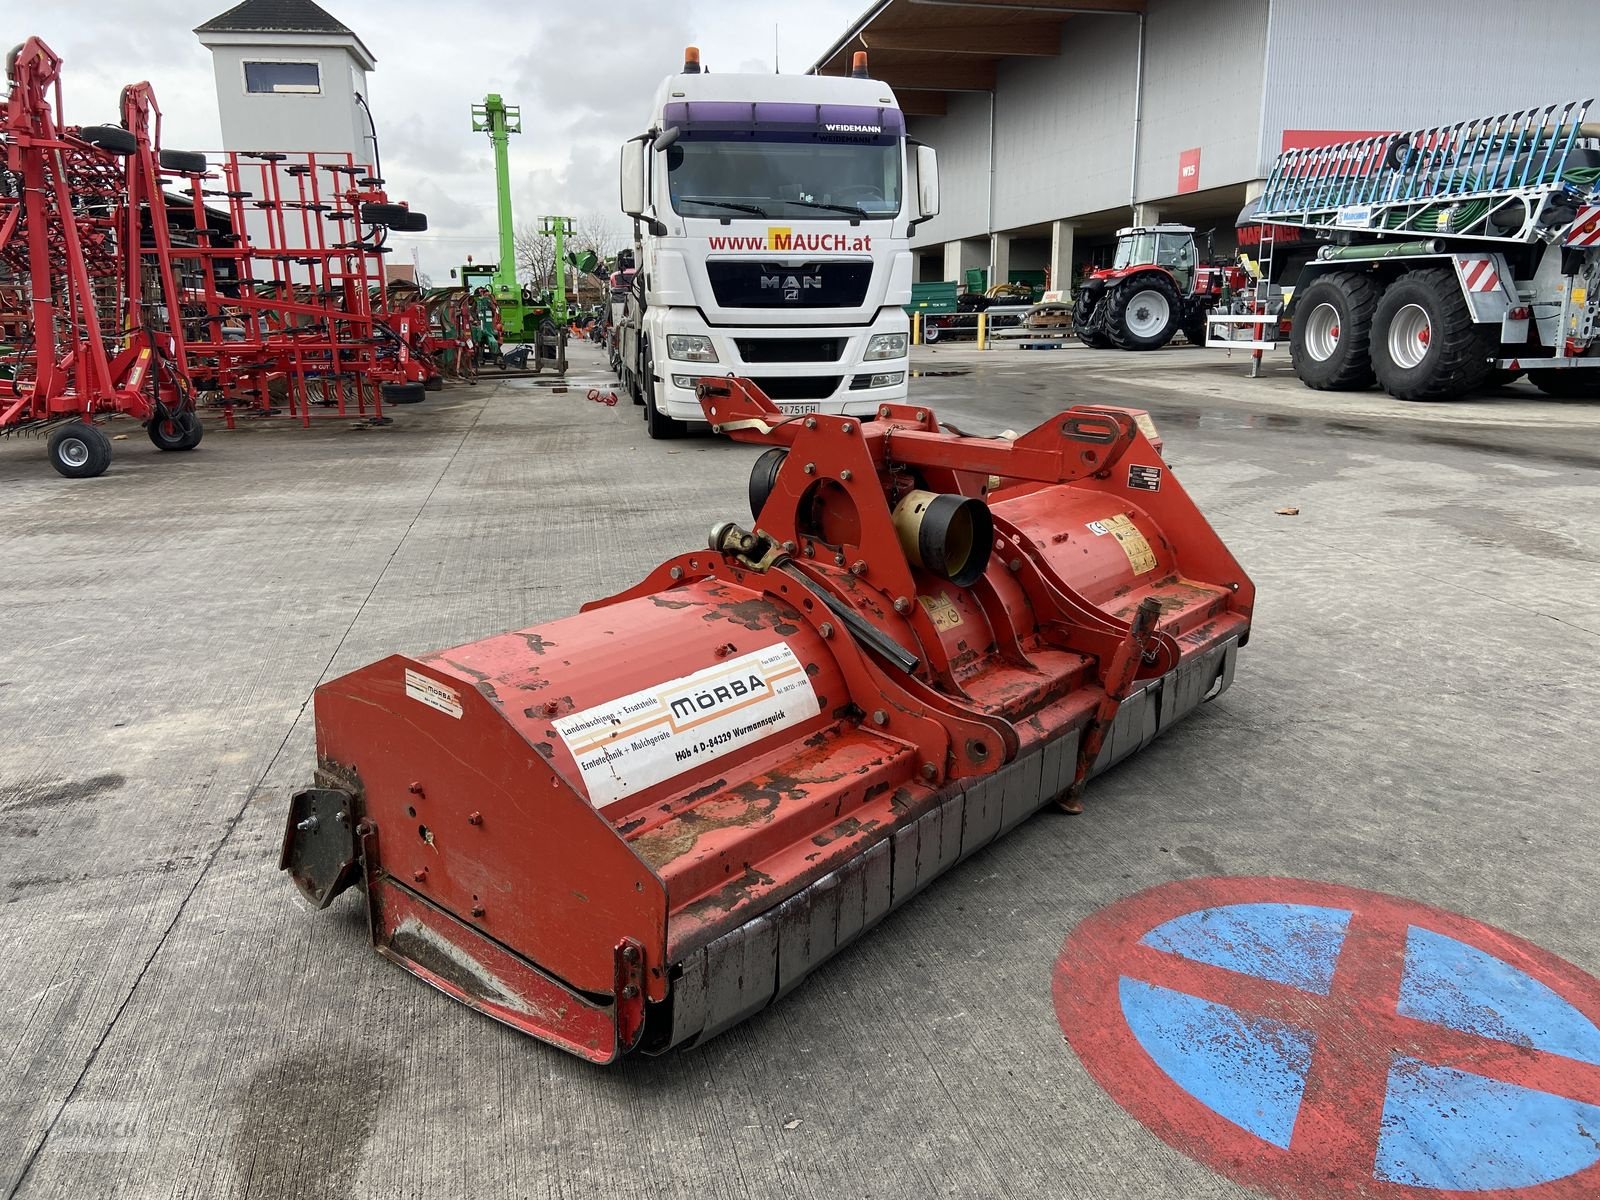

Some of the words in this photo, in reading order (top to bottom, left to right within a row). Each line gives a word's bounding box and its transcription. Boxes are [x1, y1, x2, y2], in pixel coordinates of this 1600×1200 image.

[825, 124, 881, 133] WEIDEMANN
[1182, 165, 1195, 177] W15
[760, 275, 822, 289] MAN
[670, 674, 765, 719] MÖRBA
[623, 697, 658, 714] Ersatzteile
[693, 744, 699, 754] 4
[700, 731, 732, 751] D-84329
[732, 709, 786, 738] Wurmannsquick
[581, 748, 624, 771] Erntetechnik
